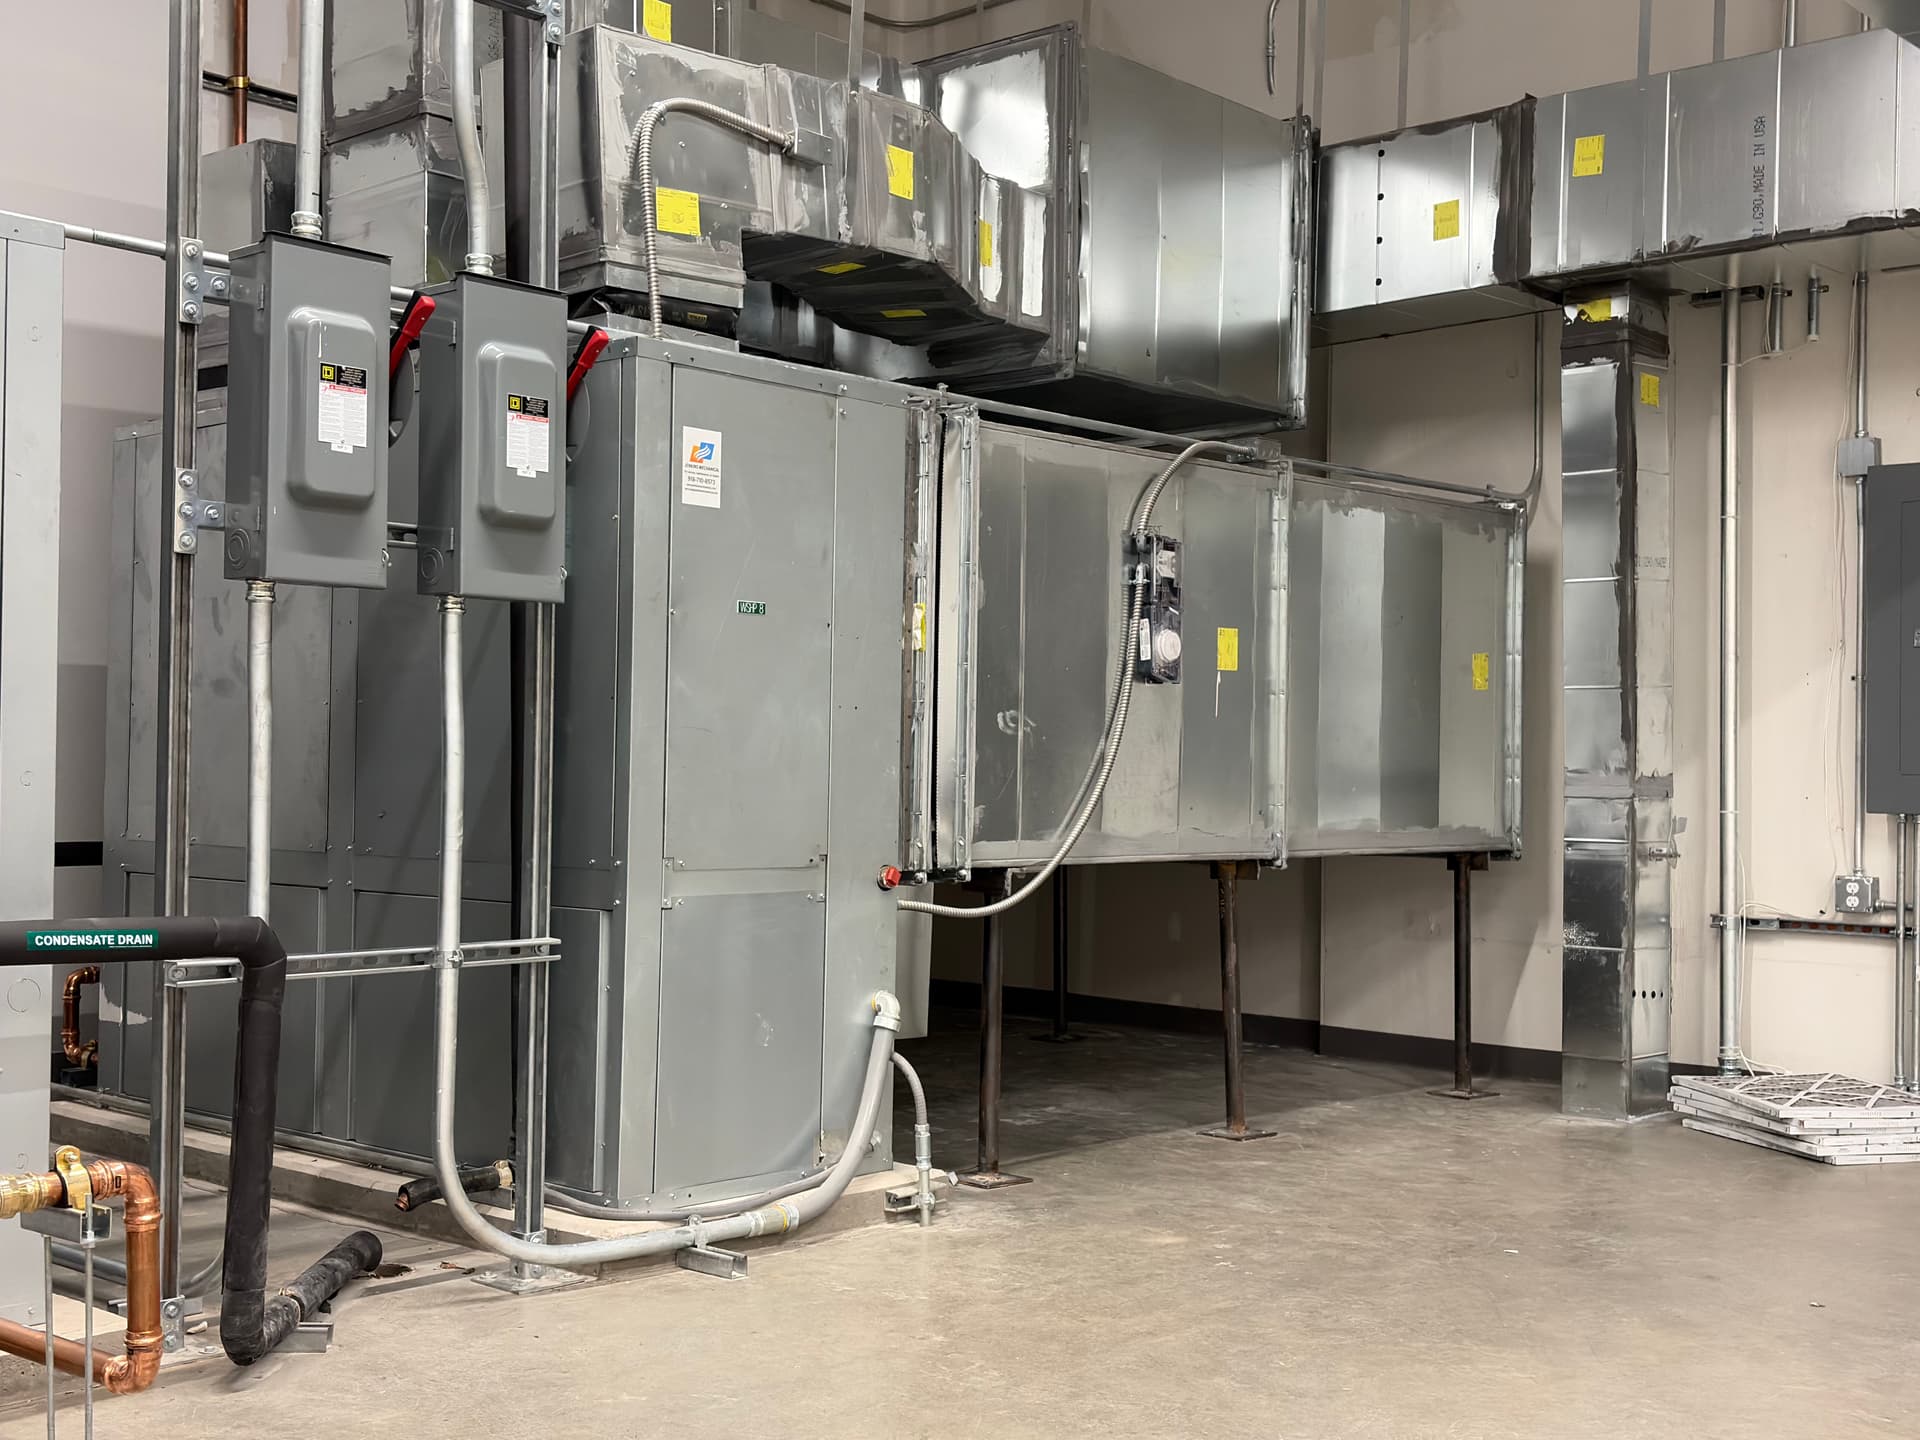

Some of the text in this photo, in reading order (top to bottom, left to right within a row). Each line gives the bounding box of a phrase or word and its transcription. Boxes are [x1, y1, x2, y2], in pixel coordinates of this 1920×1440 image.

[1753, 115, 1766, 138] USA
[1753, 143, 1765, 157] IN
[759, 603, 765, 614] 8
[35, 934, 153, 946] CONDENSATE DRAIN
